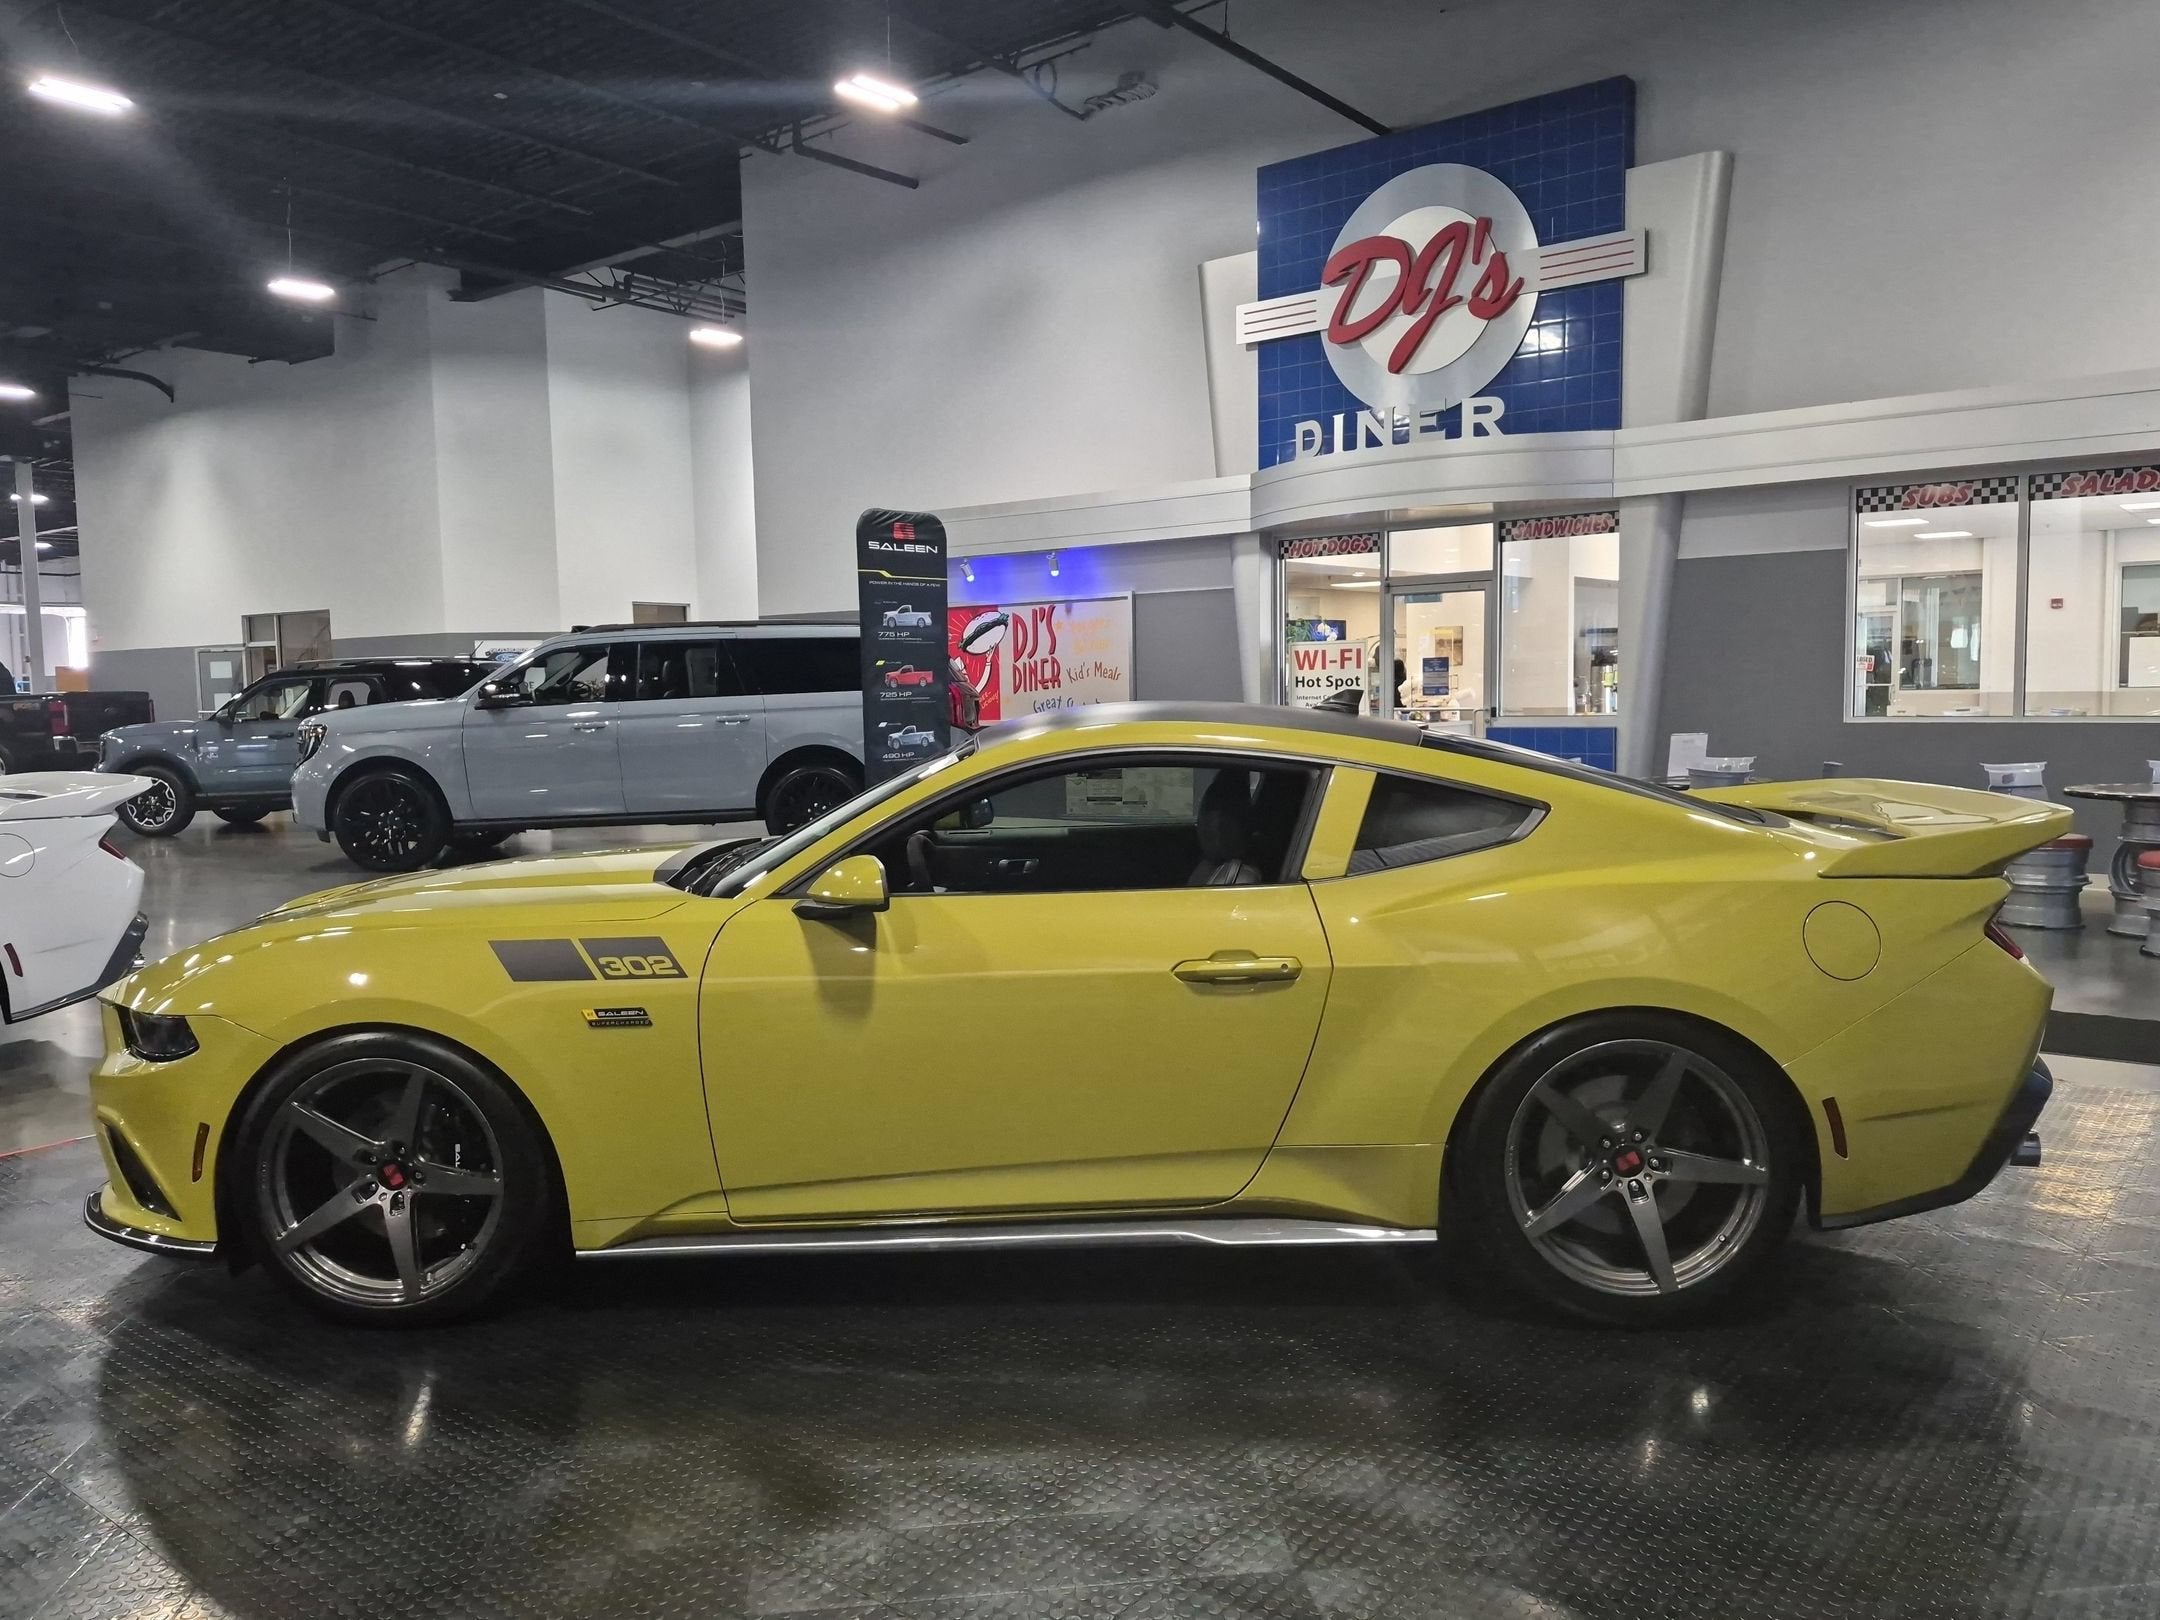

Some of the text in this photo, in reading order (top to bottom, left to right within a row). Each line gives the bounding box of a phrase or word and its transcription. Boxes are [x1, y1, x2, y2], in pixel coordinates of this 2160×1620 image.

[1322, 216, 1525, 375] DJ's
[1294, 396, 1506, 460] DINER
[2061, 470, 2160, 496] SALAD
[1903, 484, 1975, 508] SUBS
[1513, 514, 1612, 539] SANDWICHES
[868, 541, 938, 553] SALEEN
[1290, 536, 1372, 557] HOT DOGS
[1012, 604, 1056, 663] DJ'S
[1294, 647, 1362, 671] WI-FI
[1012, 656, 1061, 694] DINER
[1066, 661, 1122, 684] Kid's Meals
[1295, 675, 1360, 691] Hot Spot
[598, 956, 679, 976] 302
